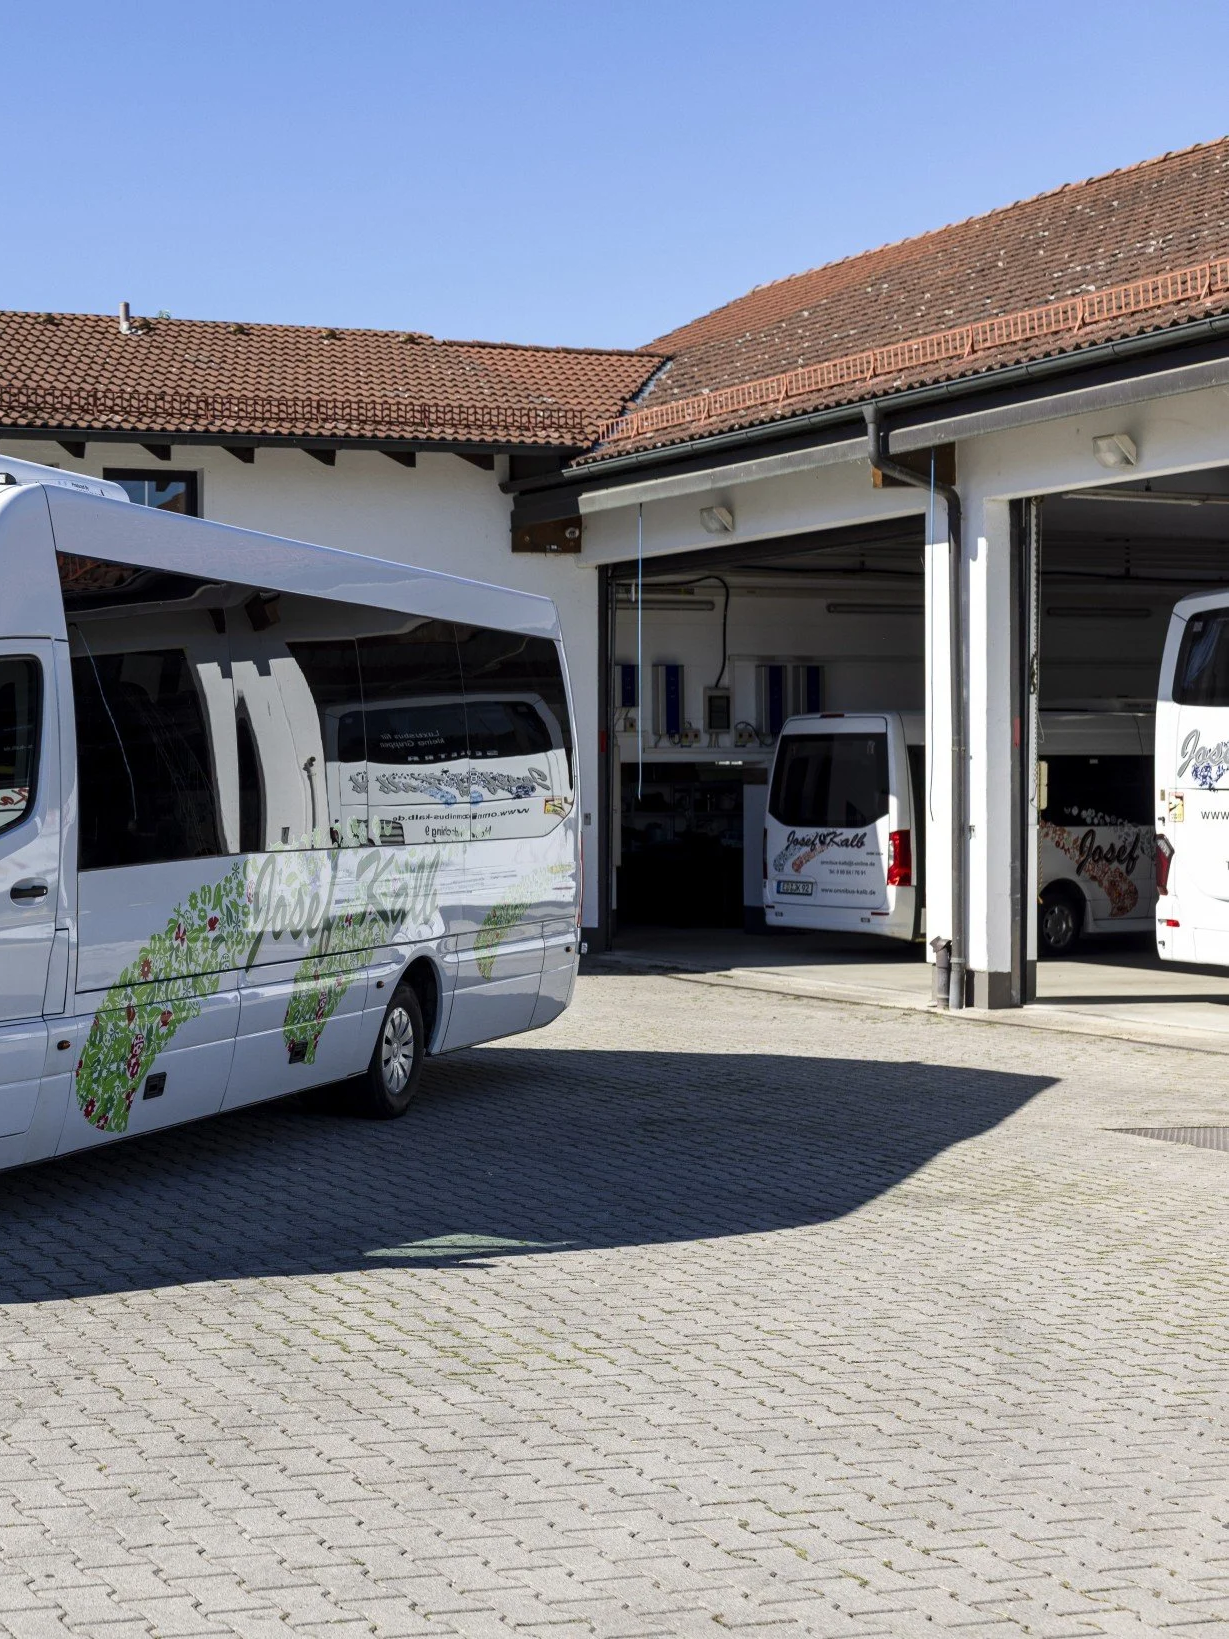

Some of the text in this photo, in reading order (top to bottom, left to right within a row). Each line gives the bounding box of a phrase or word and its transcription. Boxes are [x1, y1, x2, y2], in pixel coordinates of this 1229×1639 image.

[1177, 729, 1229, 778] Jos
[785, 830, 867, 850] Josef Kalb
[1076, 829, 1140, 877] Josef
[244, 848, 441, 974] Josef Kalb
[821, 887, 876, 896] www.omnibus-kalb.de
